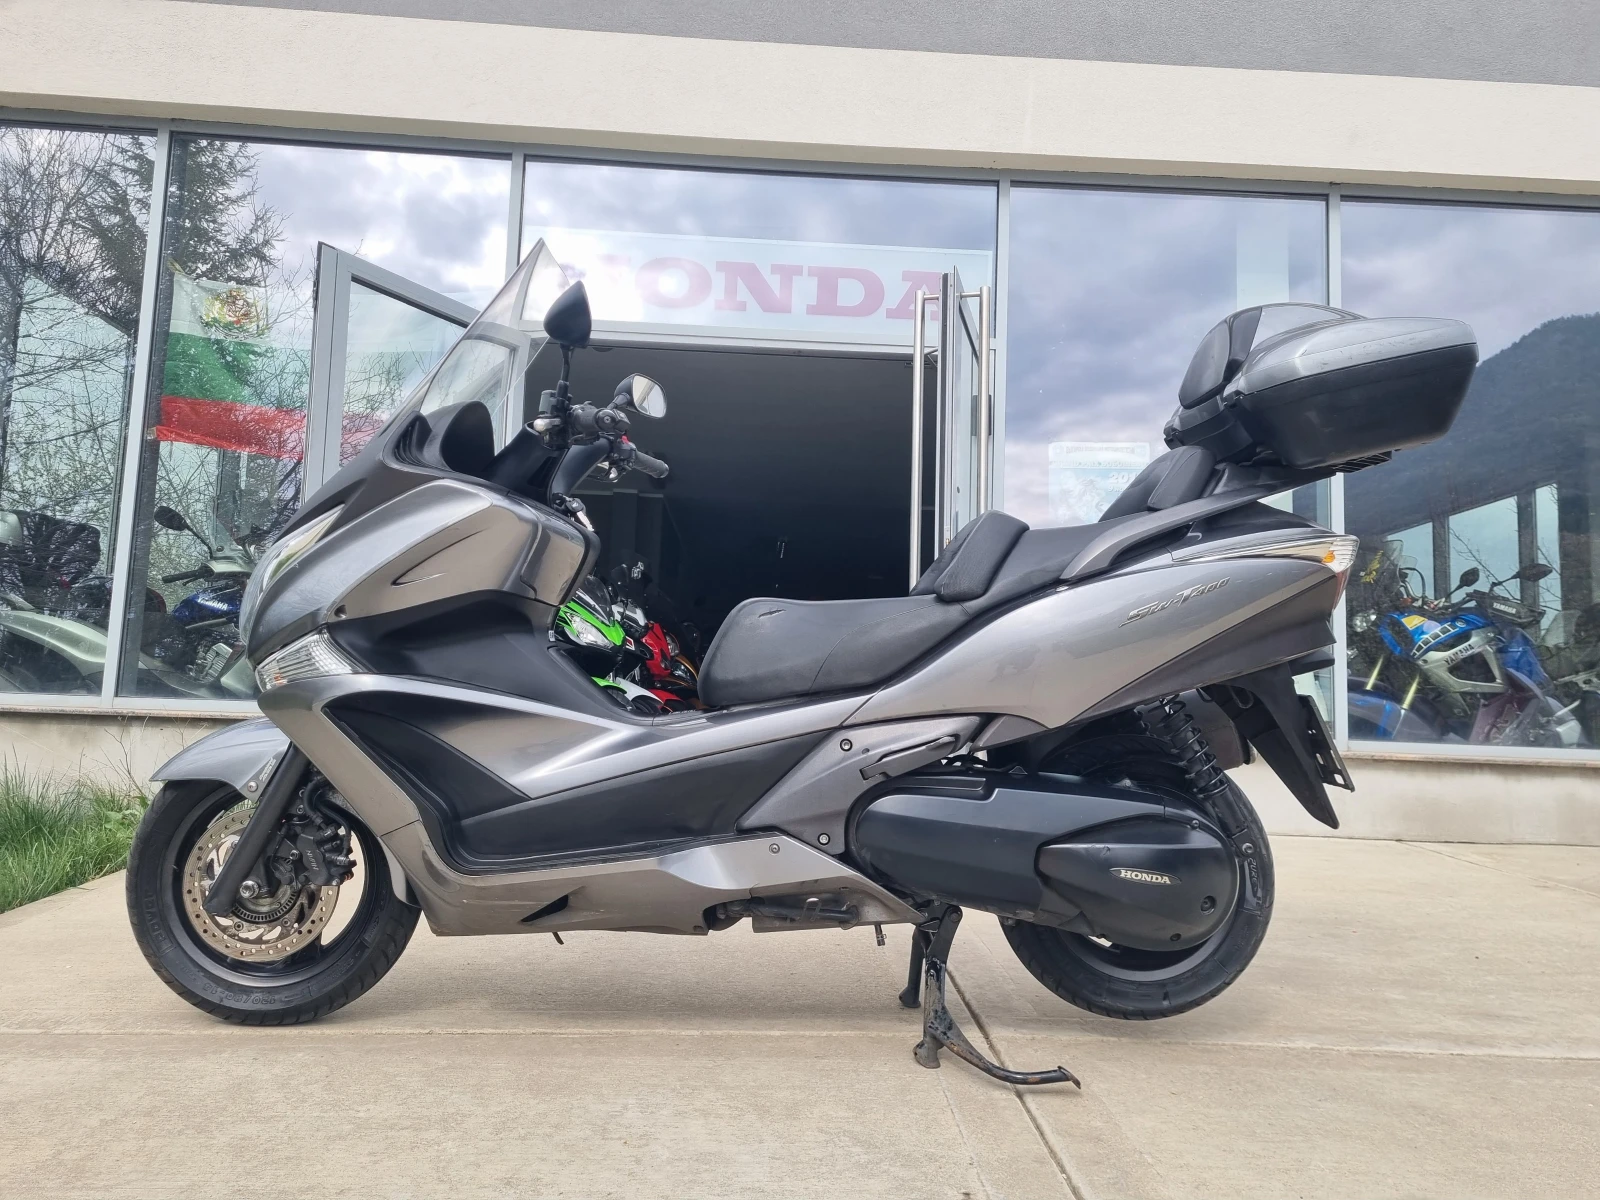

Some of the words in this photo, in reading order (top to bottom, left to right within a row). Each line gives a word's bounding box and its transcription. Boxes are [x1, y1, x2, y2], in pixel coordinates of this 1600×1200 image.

[597, 254, 941, 321] ONDA
[1108, 471, 1138, 484] 201
[1492, 602, 1517, 615] YAMAHA
[1443, 643, 1475, 666] YAMAHA
[1119, 869, 1171, 885] HONDA
